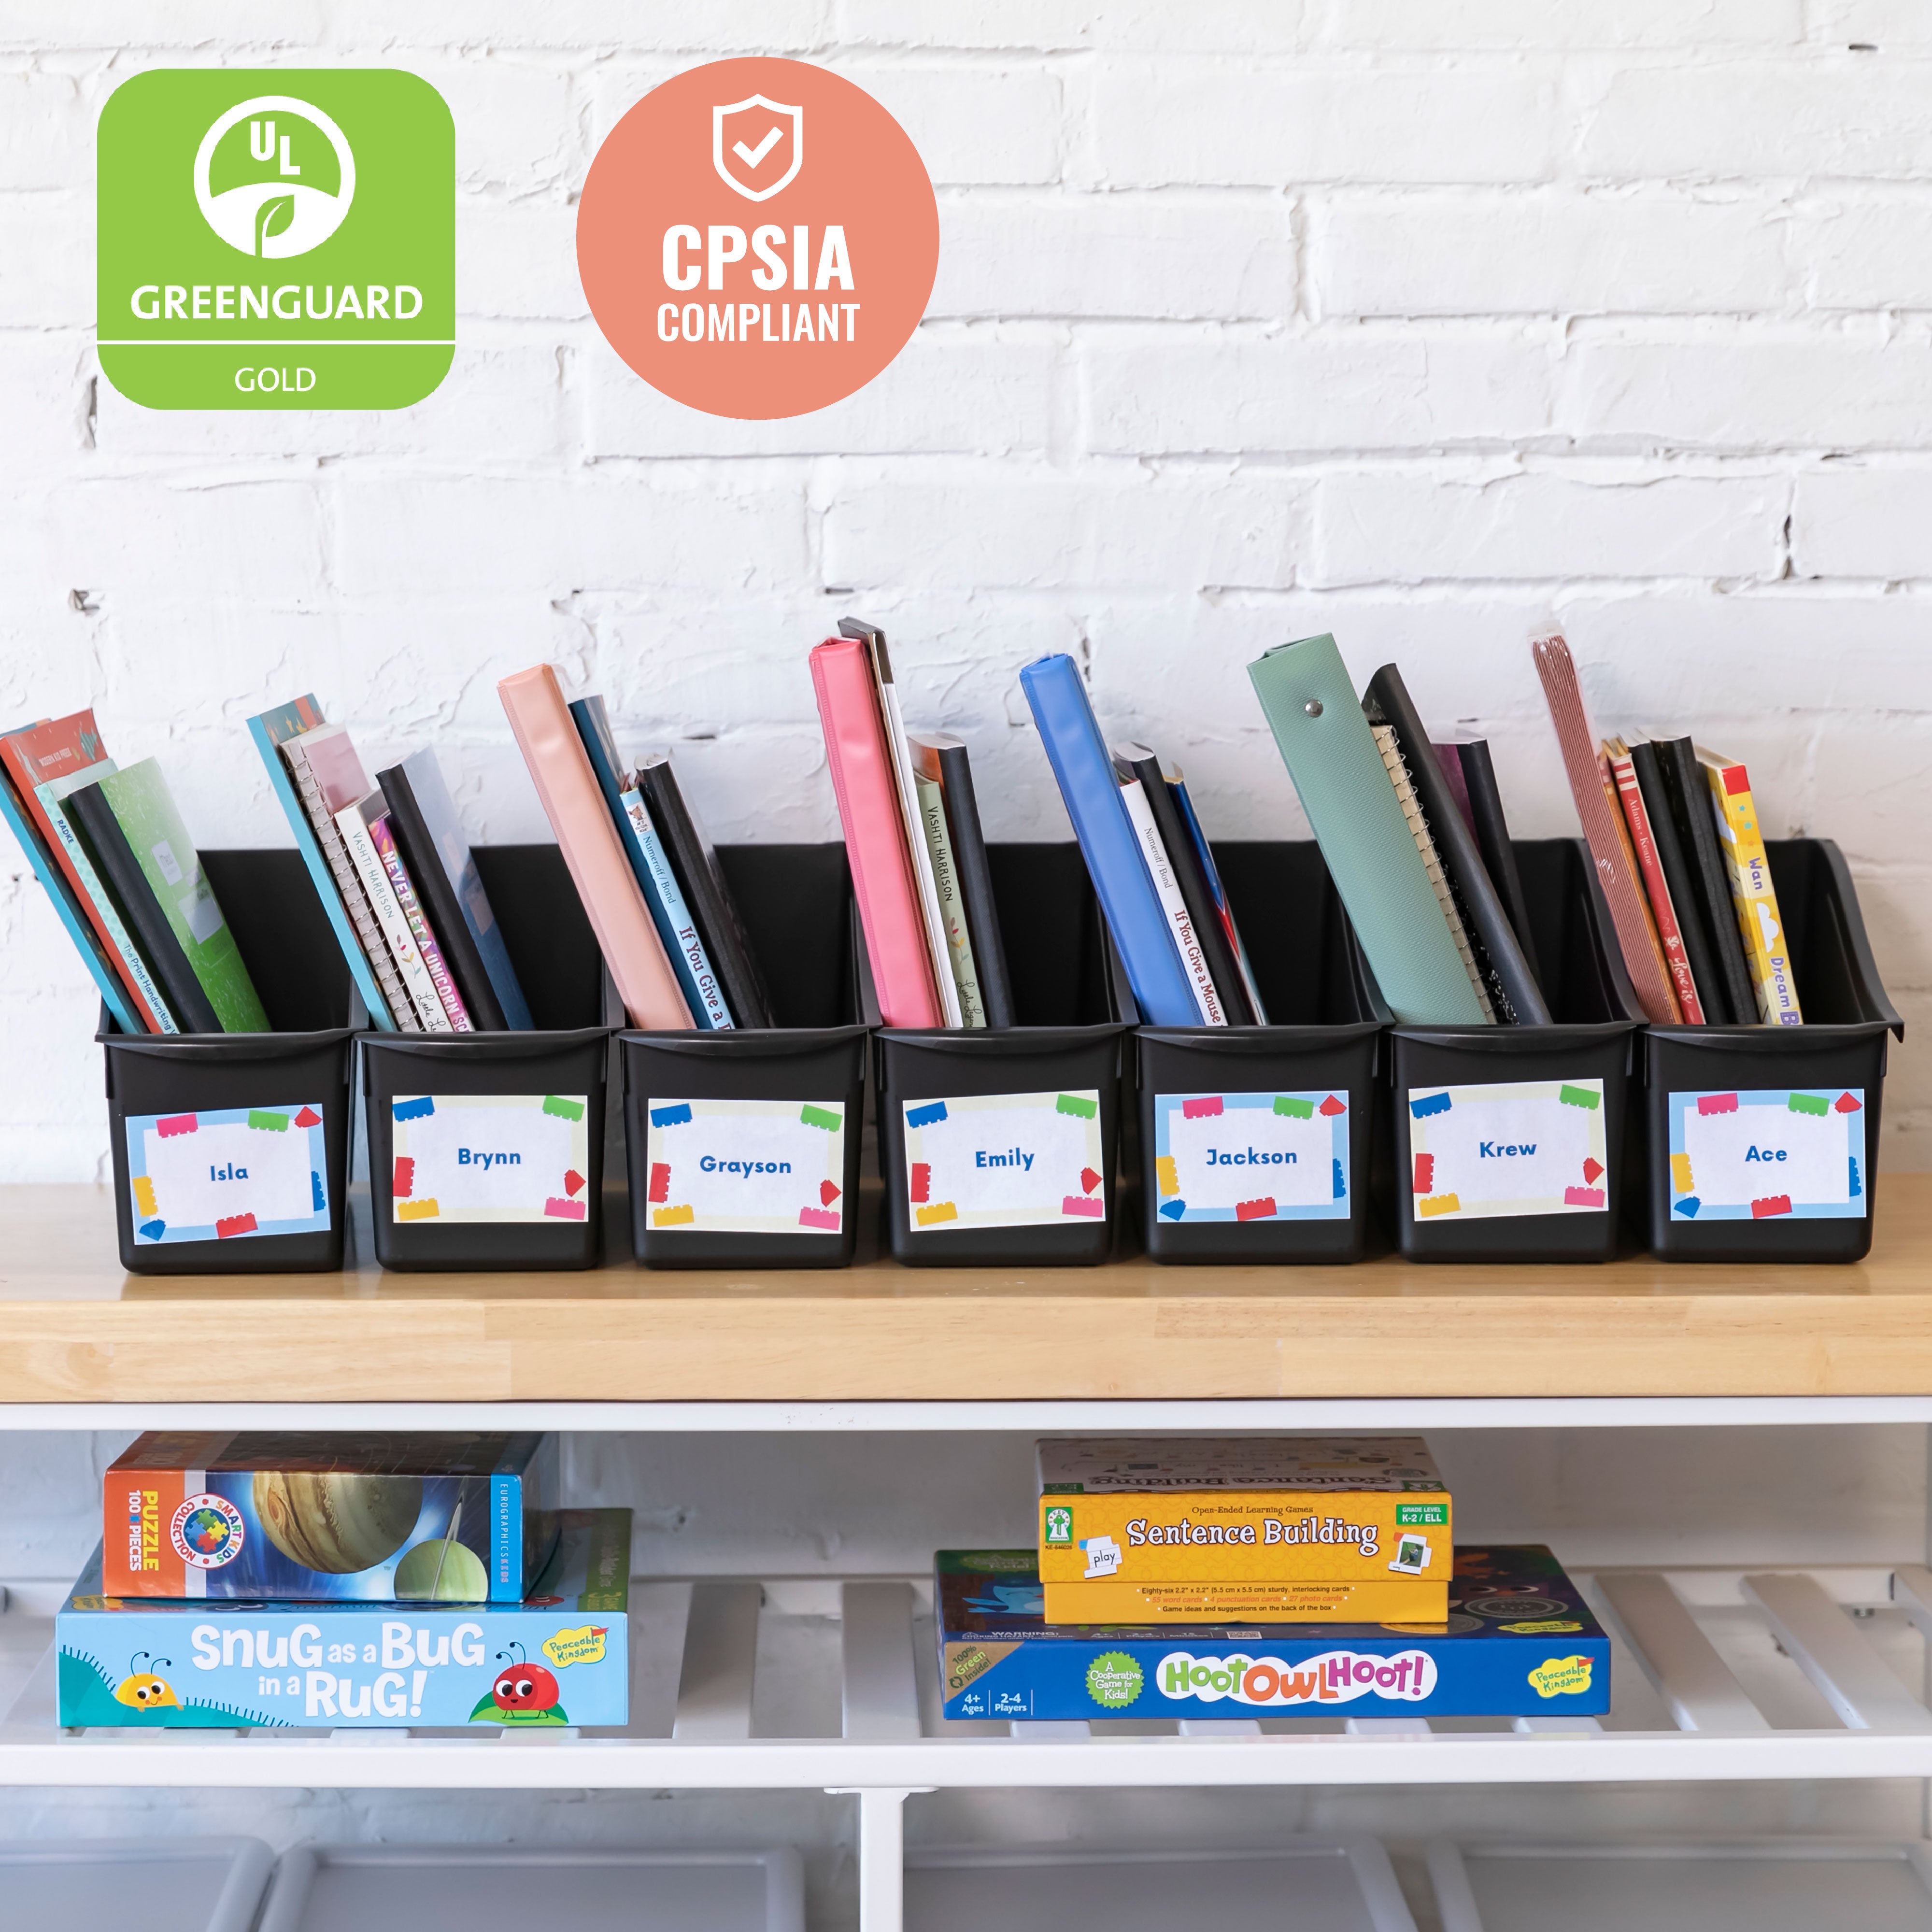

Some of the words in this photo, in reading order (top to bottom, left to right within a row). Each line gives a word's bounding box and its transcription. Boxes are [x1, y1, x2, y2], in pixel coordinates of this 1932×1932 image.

[57, 819, 74, 844] RADKE
[1629, 799, 1642, 830] Adams
[1640, 837, 1652, 866] Keane
[928, 806, 942, 843] VASHTI
[936, 849, 953, 902] HARRISON
[1144, 827, 1164, 863] Numeroff
[1159, 868, 1173, 888] Bond
[353, 831, 372, 867] VASHTI
[368, 869, 394, 918] HARRISON
[643, 836, 666, 875] Numeroff
[661, 881, 676, 904] Bond
[1748, 857, 1763, 890] Wan
[1174, 909, 1188, 922] If
[383, 851, 412, 903] NEVER
[405, 906, 427, 934] LET
[418, 941, 432, 952] A
[426, 953, 460, 1014] UNICORN
[679, 926, 696, 940] If
[1179, 922, 1193, 945] You
[686, 941, 704, 972] You
[1188, 947, 1203, 974] Give
[124, 944, 132, 958] The
[131, 958, 145, 980] Print
[143, 980, 171, 1030] Handwriting
[699, 975, 718, 1008] Give
[1770, 957, 1790, 1008] Dream
[1201, 983, 1221, 1023] Mouse
[712, 1011, 723, 1022] a
[458, 1148, 520, 1170] Brynn
[976, 1148, 1034, 1171] Emily
[1207, 1147, 1296, 1165] Jackson
[1480, 1142, 1536, 1158] Krew
[1745, 1146, 1787, 1162] Ace
[211, 1163, 248, 1181] Isla
[700, 1156, 791, 1179] Grayson
[129, 1490, 141, 1513] 100
[1192, 1506, 1243, 1515] Open-Ended
[1246, 1506, 1284, 1516] Learning
[215, 1500, 242, 1538] SMART
[1402, 1514, 1417, 1522] K-2
[1425, 1514, 1442, 1522] ELL
[142, 1491, 159, 1571] PUZZLE
[173, 1502, 196, 1561] COLLECTION
[1126, 1518, 1256, 1546] Sentence
[1264, 1517, 1379, 1557] Building
[129, 1525, 142, 1571] PIECES
[216, 1540, 240, 1563] KIDS
[1094, 1550, 1115, 1568] play
[1216, 1595, 1260, 1604] punctuation
[1300, 1595, 1321, 1603] photo
[327, 1644, 356, 1663] as
[363, 1644, 376, 1663] a
[549, 1635, 600, 1652] Peaceable
[952, 1645, 977, 1663] 100%
[557, 1648, 597, 1662] Kingdom
[955, 1651, 986, 1675] Green
[965, 1658, 991, 1681] Inside!
[1090, 1670, 1140, 1680] Cooperative
[1105, 1662, 1114, 1671] A
[1536, 1666, 1586, 1682] Peaceable
[259, 1676, 280, 1695] in
[286, 1676, 300, 1695] a
[1095, 1680, 1122, 1689] Game
[1105, 1688, 1128, 1700] Kids!
[1543, 1678, 1583, 1692] Kingdom
[965, 1694, 980, 1704] 4+
[995, 1704, 1027, 1714] Players
[1001, 1693, 1021, 1703] 2-4
[962, 1704, 984, 1715] Ages
